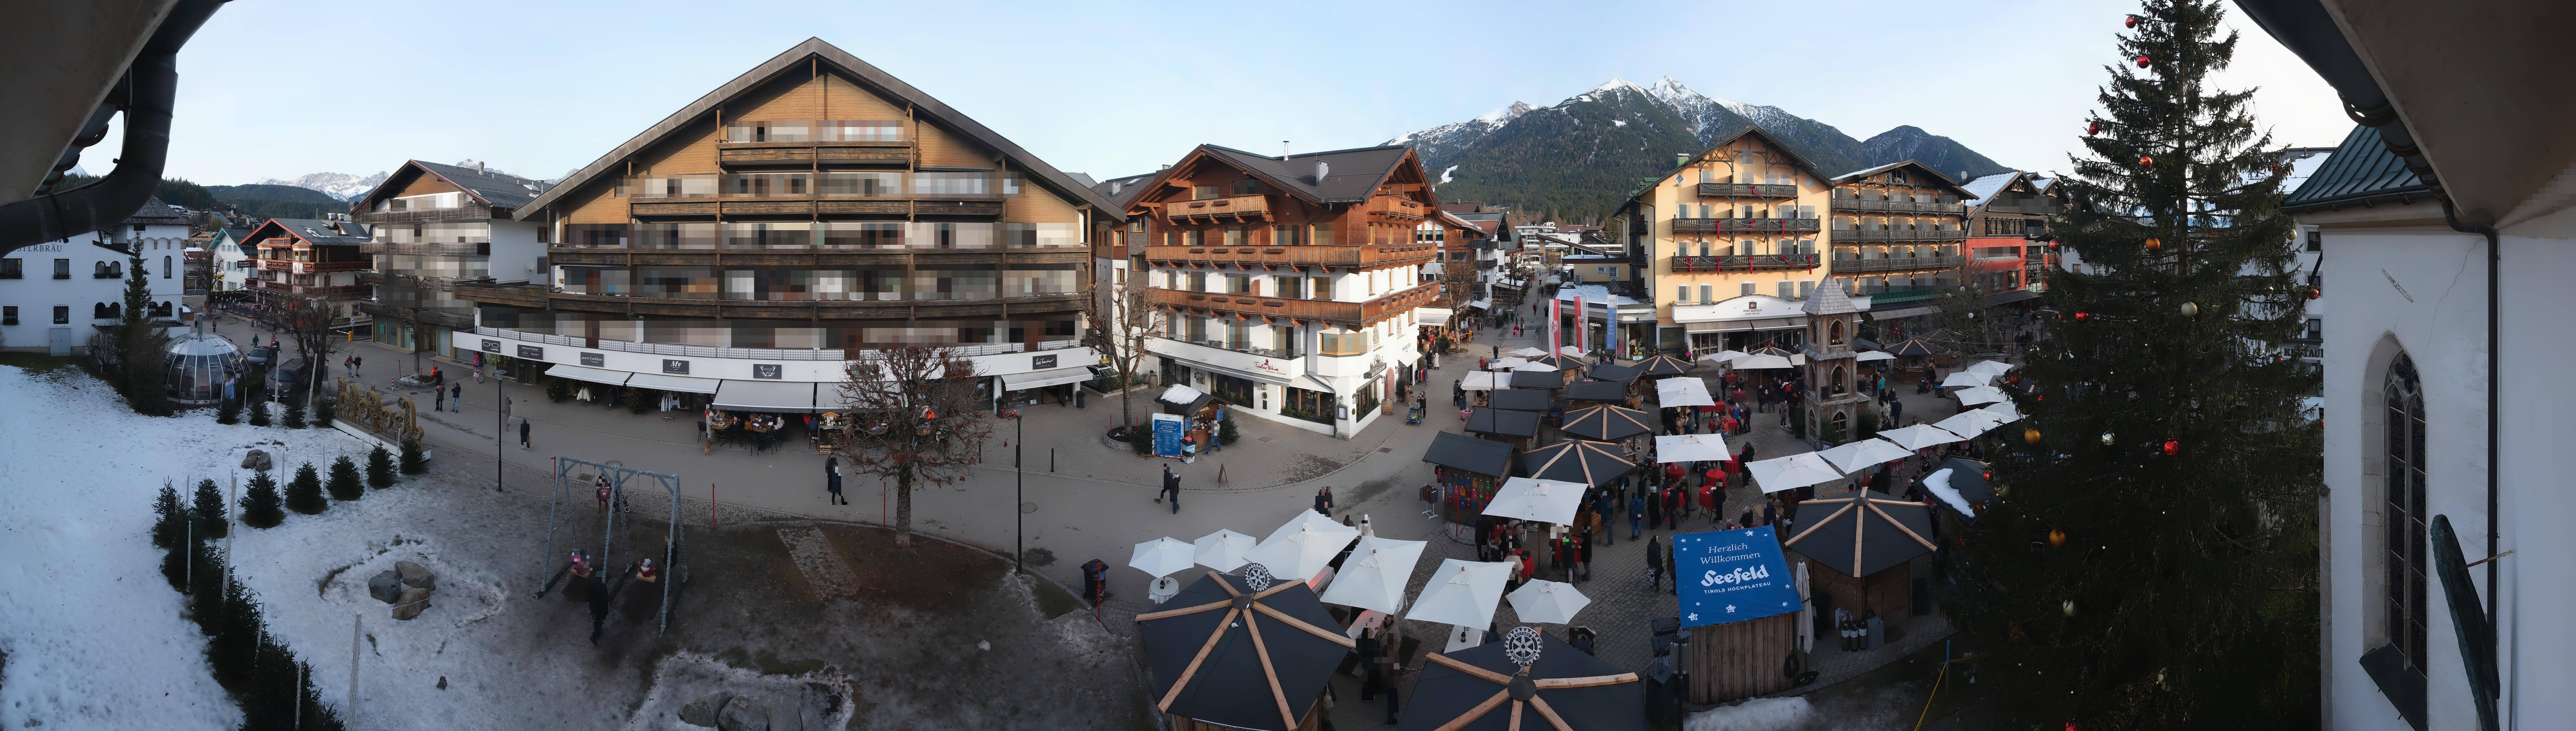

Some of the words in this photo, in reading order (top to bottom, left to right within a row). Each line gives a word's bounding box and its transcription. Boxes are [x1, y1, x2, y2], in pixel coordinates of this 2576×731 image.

[1402, 343, 1411, 351] SAILER
[1371, 364, 1386, 377] RESTAURANT
[1708, 543, 1748, 553] Herzlich
[1700, 552, 1761, 564] Willkommen
[1701, 564, 1769, 586] Seefeld
[1248, 578, 1265, 588] INTERNAIONAL
[1728, 582, 1770, 591] HOCHPLATEAU
